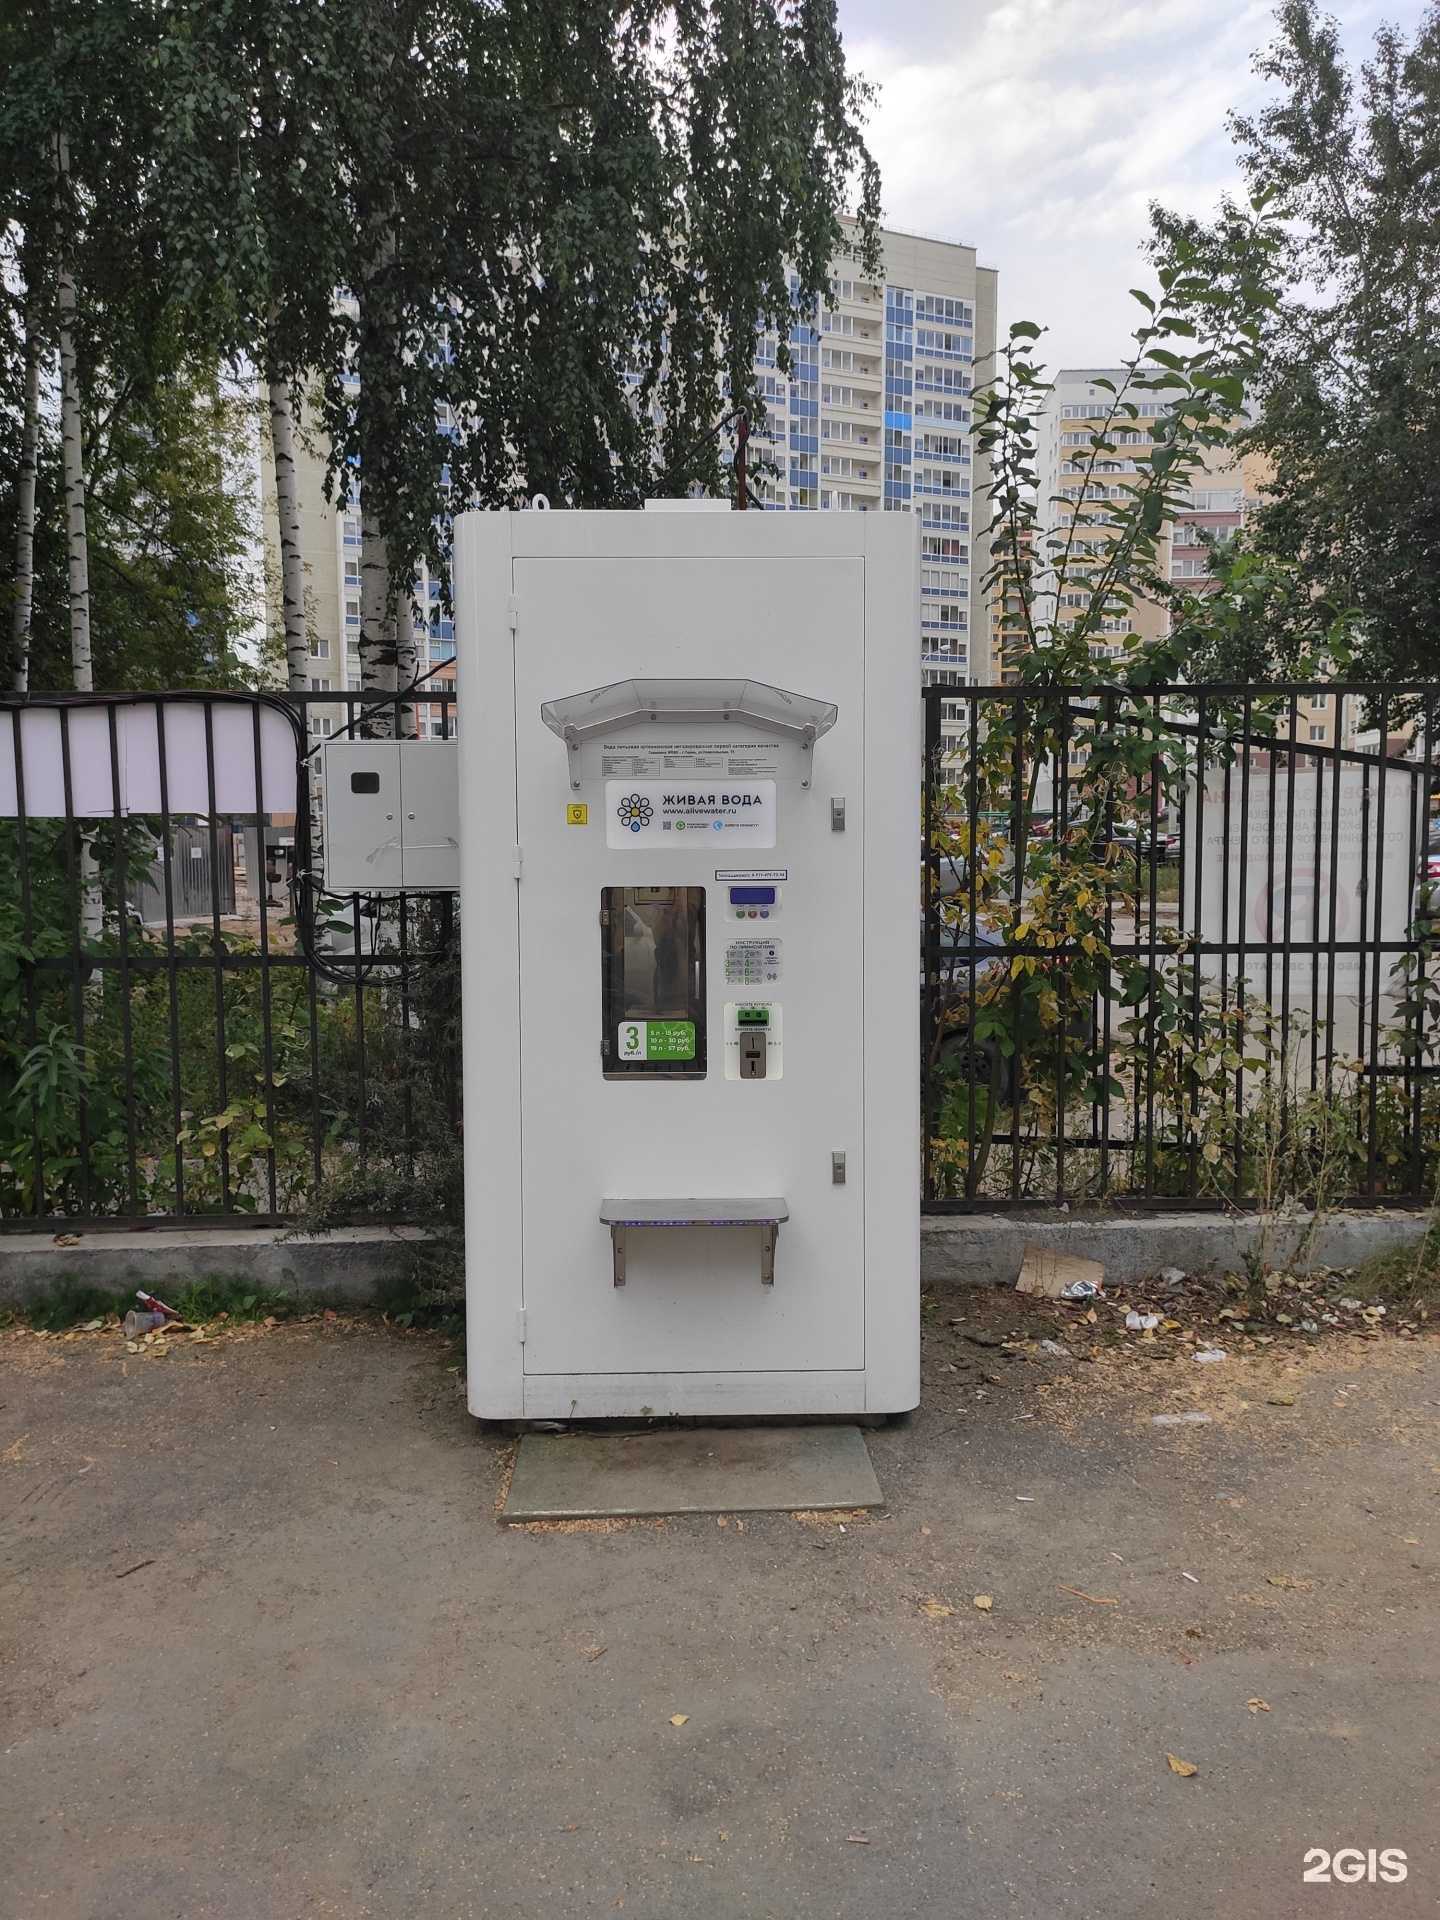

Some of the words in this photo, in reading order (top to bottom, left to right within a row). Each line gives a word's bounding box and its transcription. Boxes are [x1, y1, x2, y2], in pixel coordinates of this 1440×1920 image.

[662, 795, 717, 806] ЖИВАЯ
[721, 795, 762, 807] ВОДА
[662, 807, 737, 815] www.alivewater.ru
[626, 1026, 639, 1050] 3
